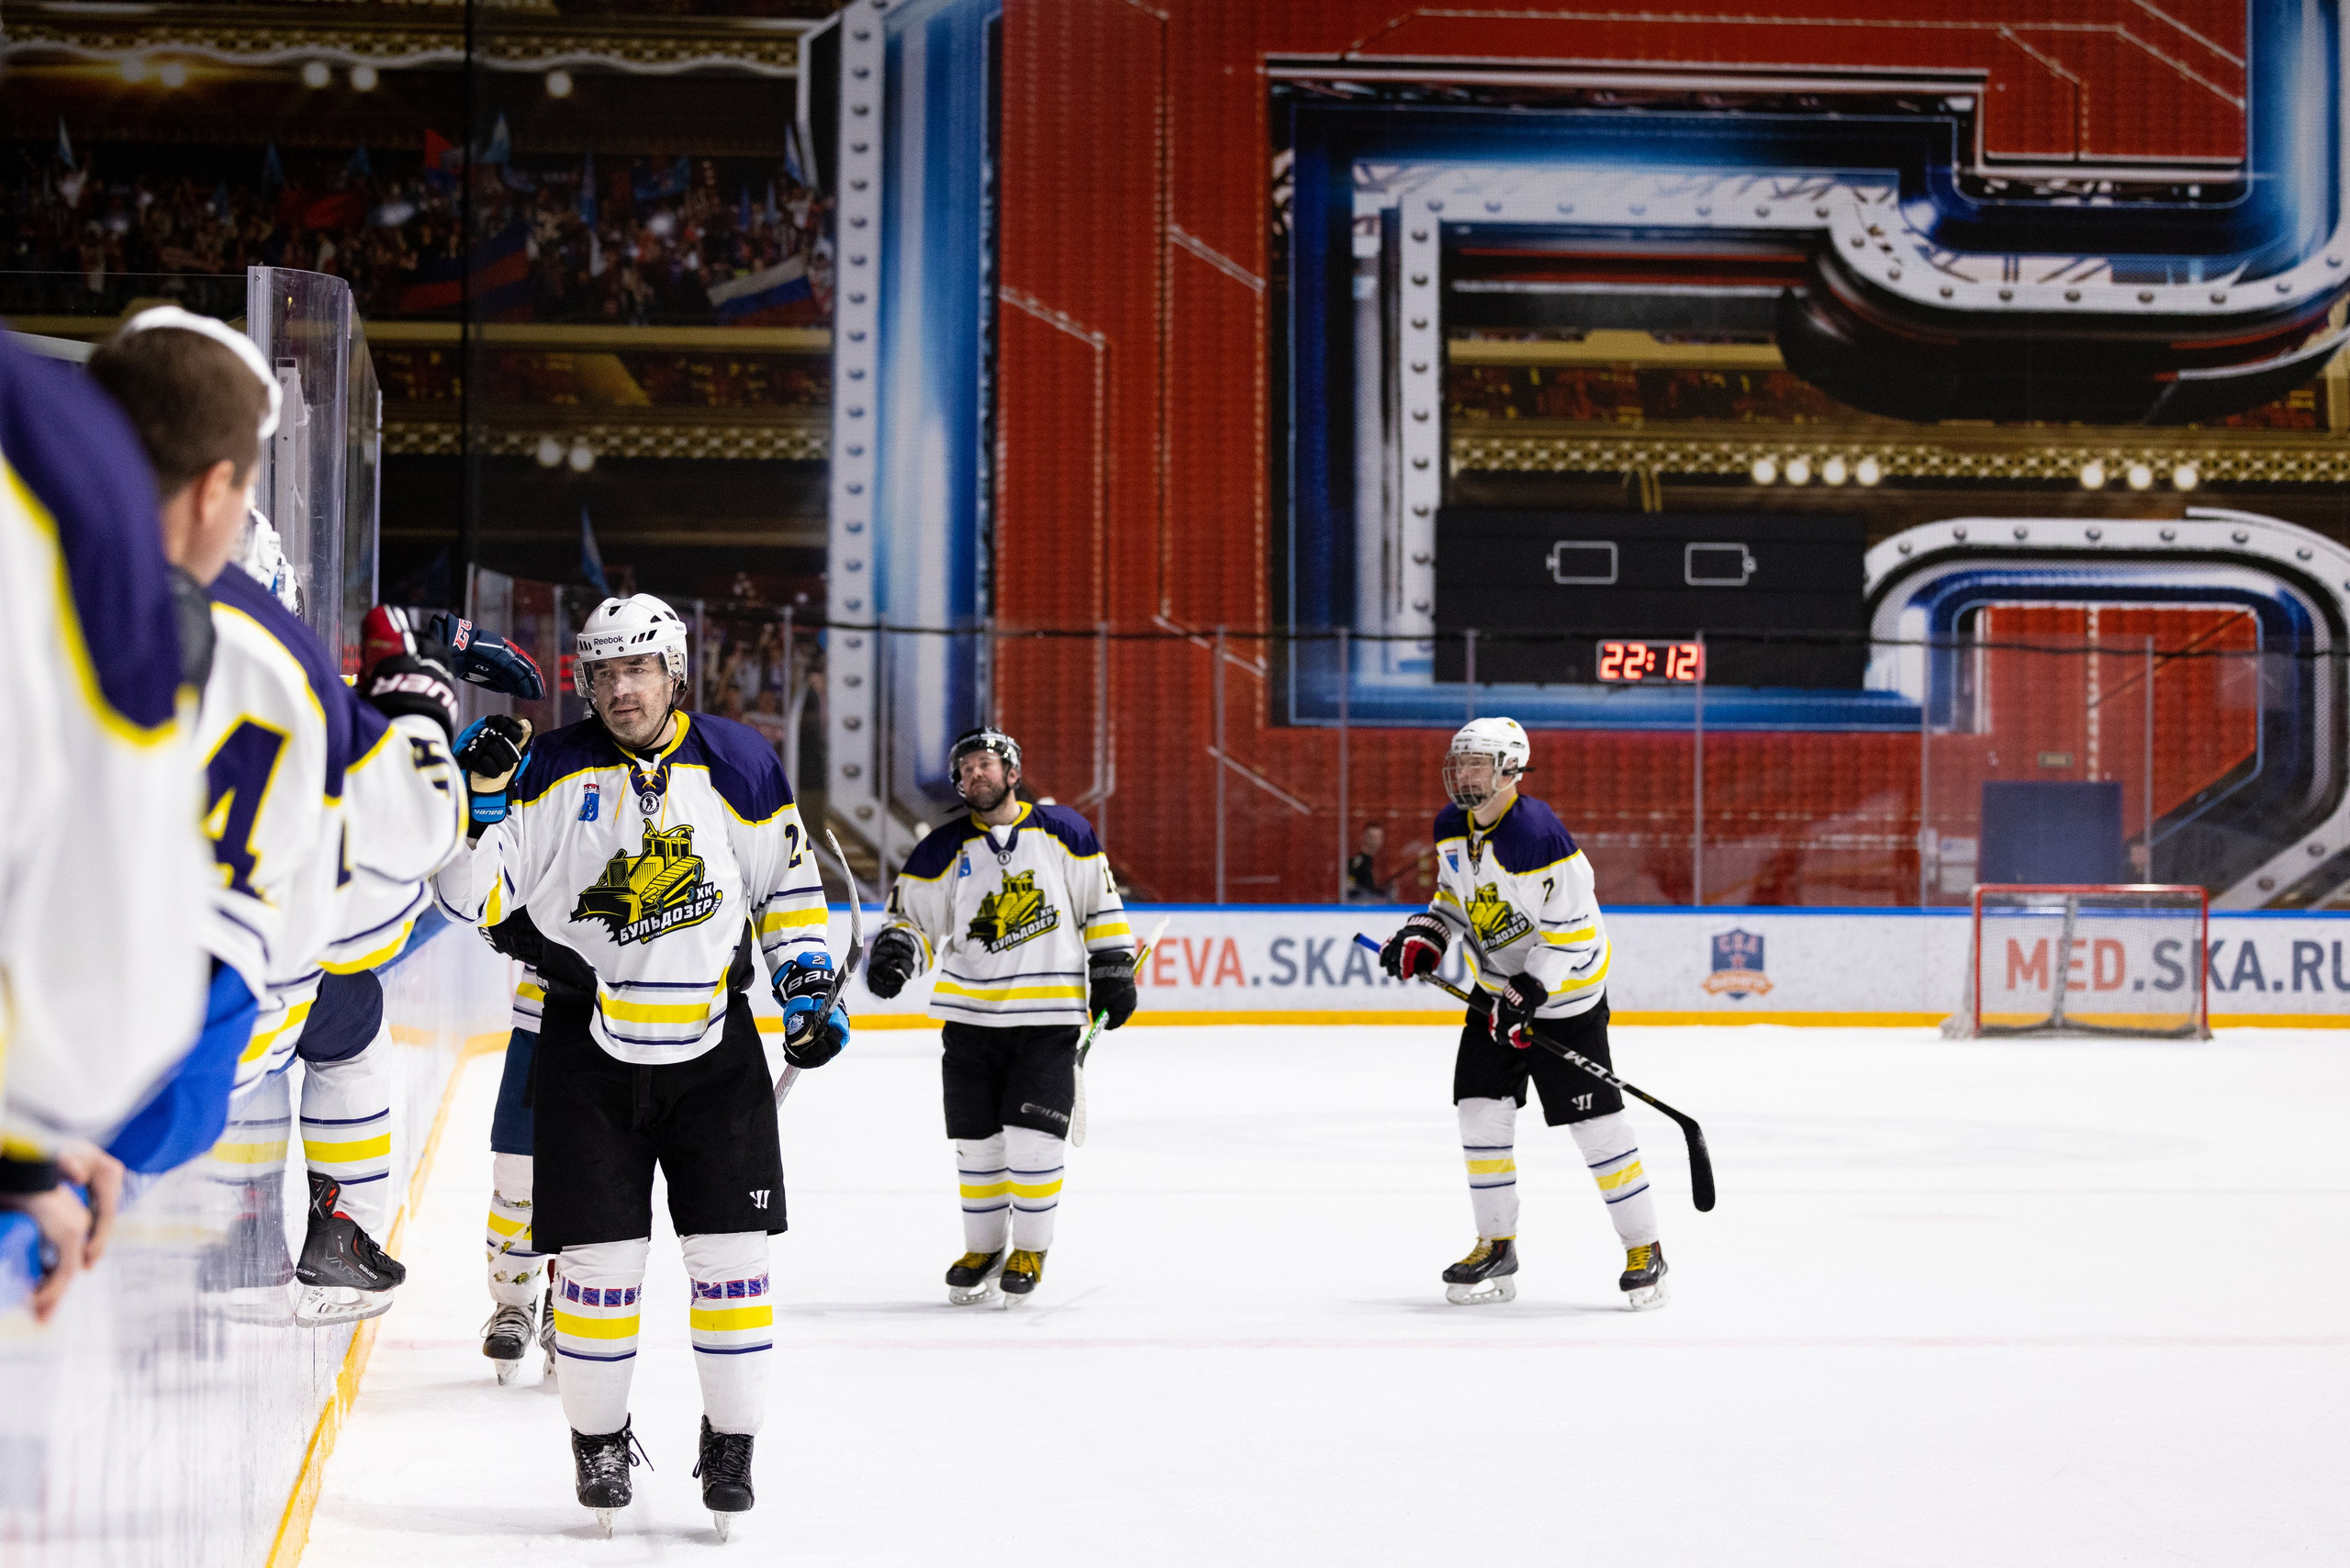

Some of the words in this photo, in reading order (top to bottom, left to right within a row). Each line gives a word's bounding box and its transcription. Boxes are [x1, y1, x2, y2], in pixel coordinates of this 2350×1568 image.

[453, 618, 473, 651] CC
[593, 635, 623, 646] Reebok
[1599, 643, 1700, 680] 22:12
[697, 883, 714, 901] ХК
[1542, 877, 1554, 905] 7
[620, 899, 713, 943] БУЛЬДОЗЕР
[1040, 907, 1054, 918] ХК
[990, 916, 1055, 952] БУЛЬДОЗЕР
[1481, 920, 1528, 951] ЛЬДОЗЕР
[1562, 1050, 1628, 1090] CCM
[358, 1263, 378, 1281] BAUER
